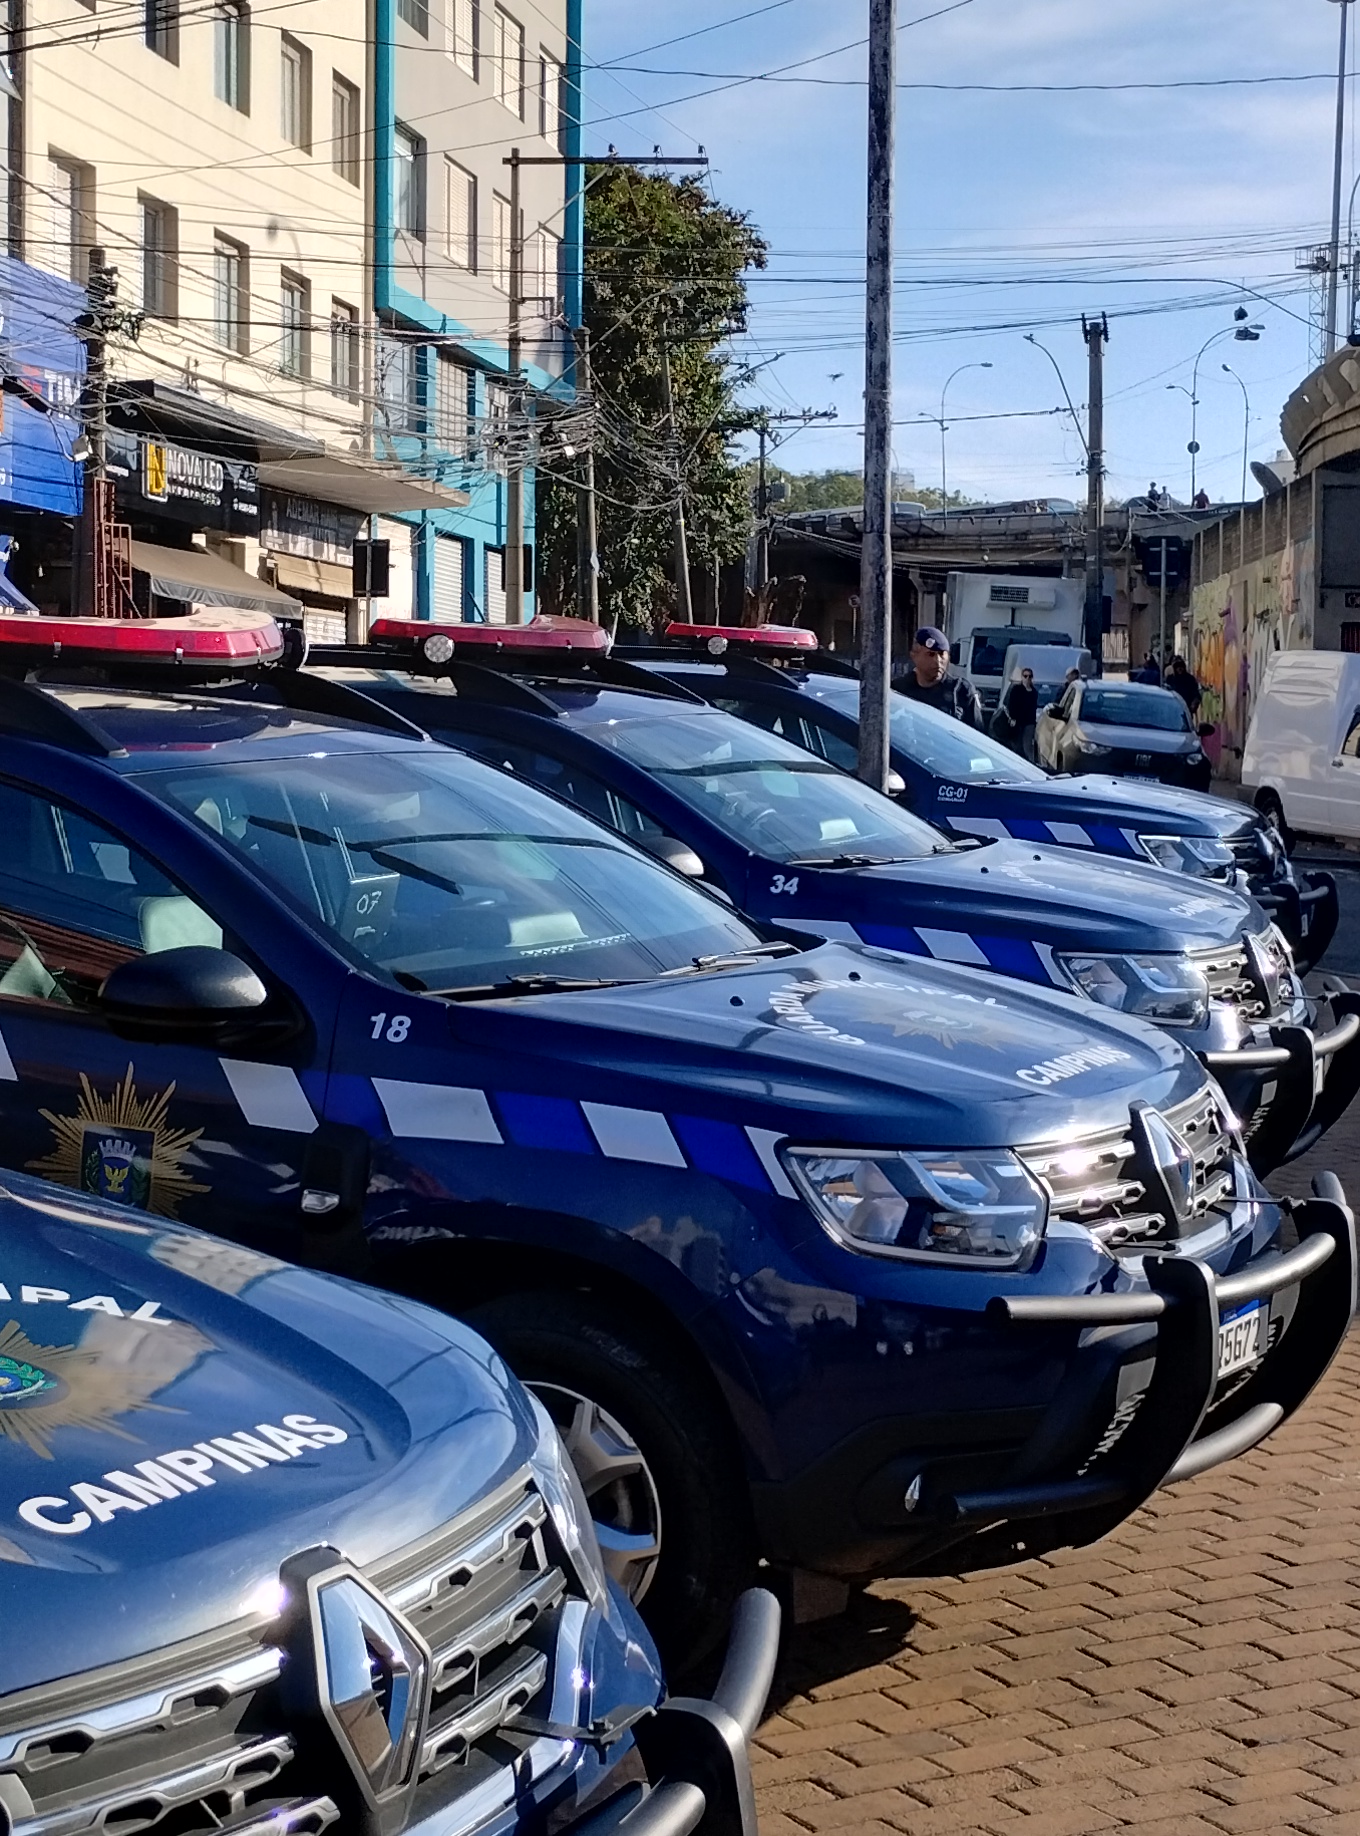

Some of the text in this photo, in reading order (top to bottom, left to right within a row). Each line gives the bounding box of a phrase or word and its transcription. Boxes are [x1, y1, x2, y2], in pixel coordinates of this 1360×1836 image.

[939, 785, 968, 799] CG-01
[770, 875, 799, 895] 34
[370, 1012, 411, 1043] 18
[769, 979, 1008, 1046] GUARDA MUNICIPAL
[1015, 1045, 1131, 1086] CAMPINAS
[17, 1413, 348, 1536] CAMPINAS
